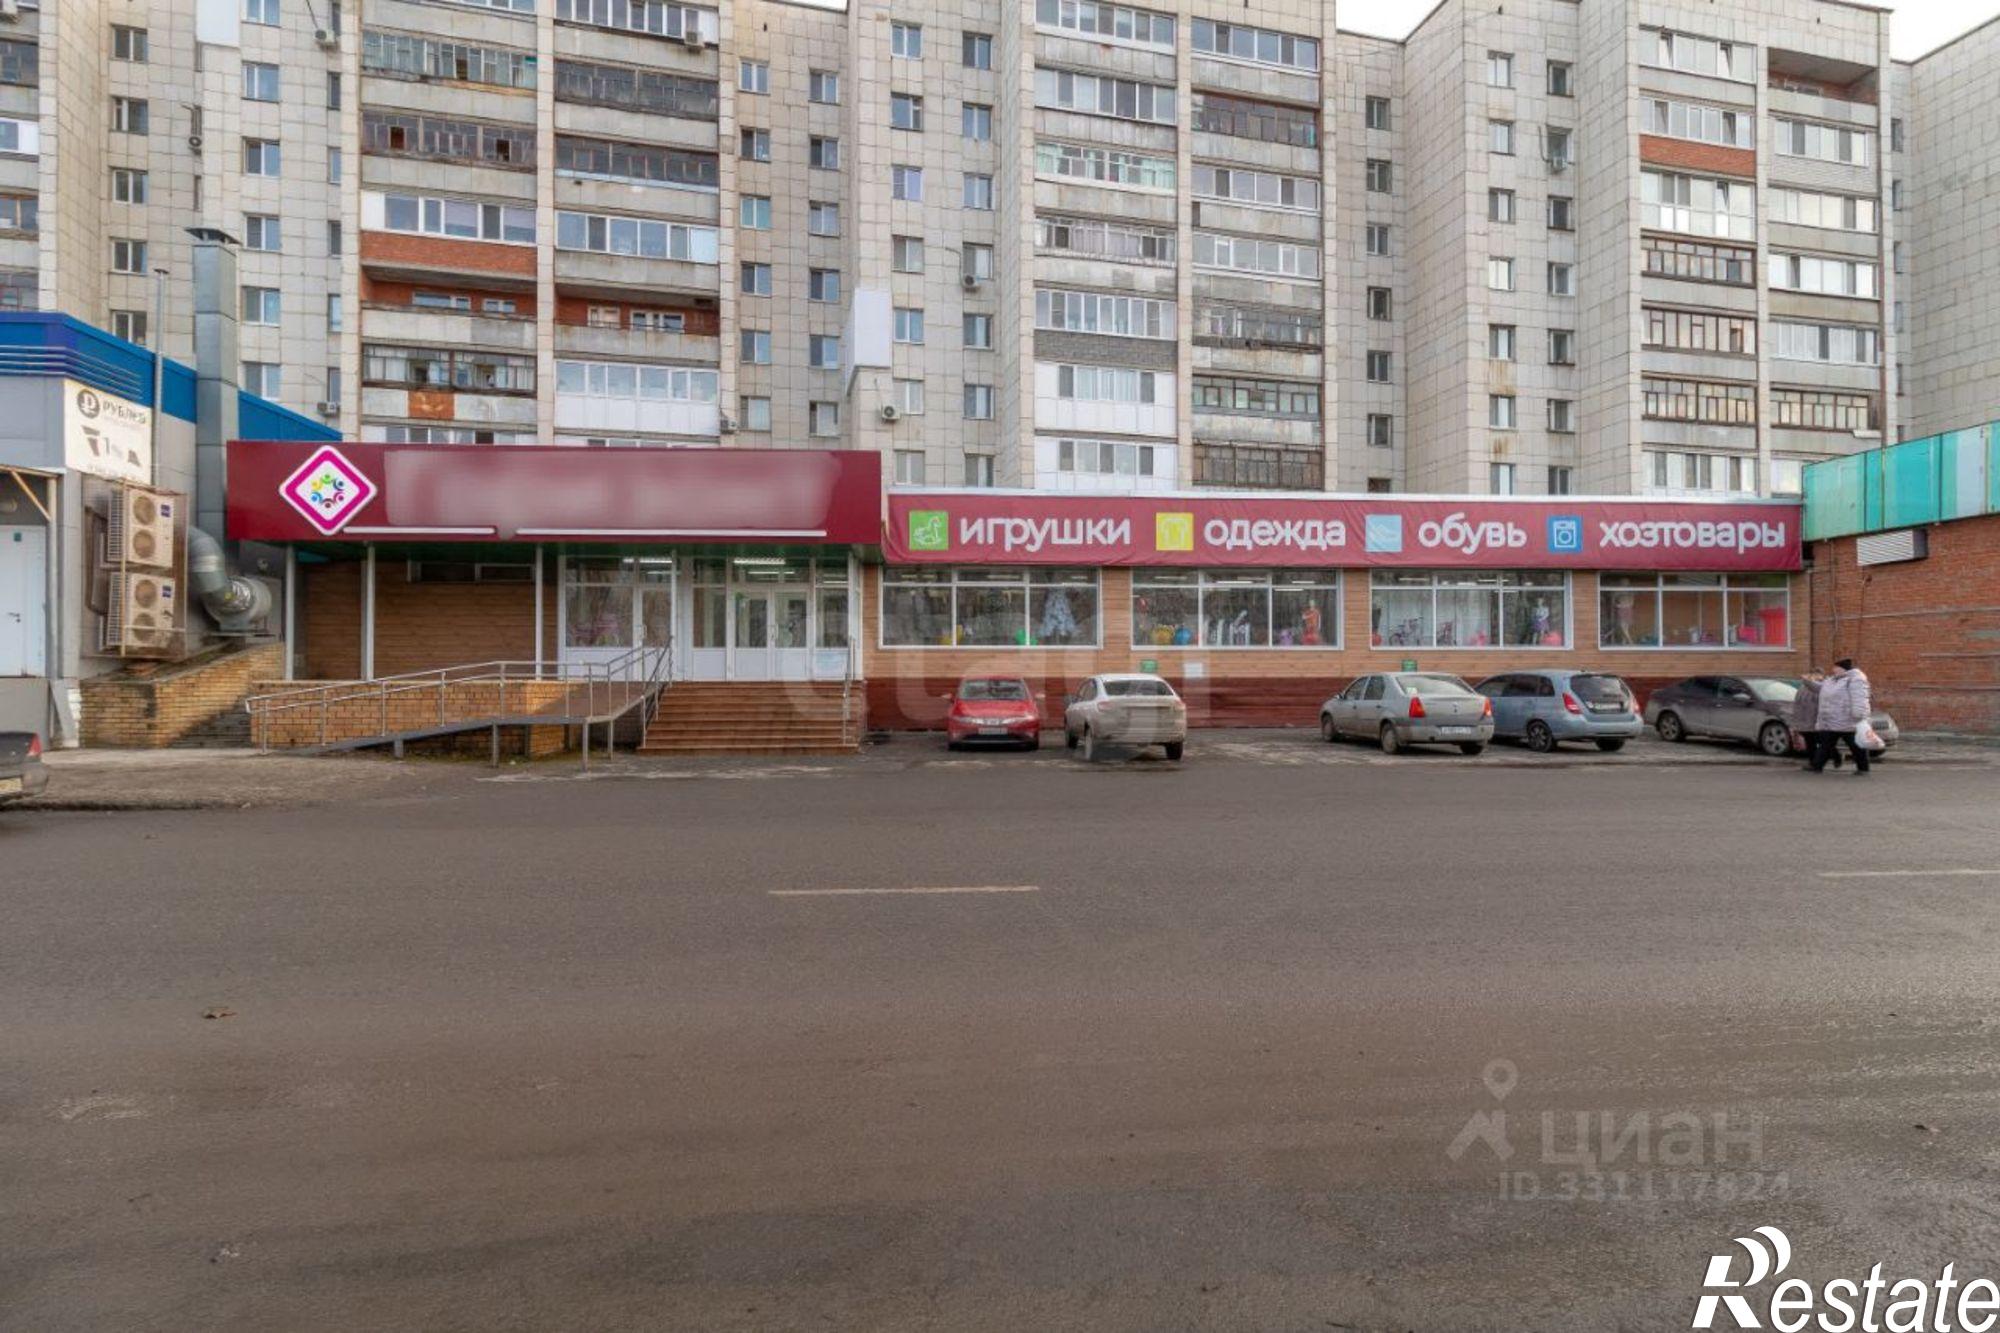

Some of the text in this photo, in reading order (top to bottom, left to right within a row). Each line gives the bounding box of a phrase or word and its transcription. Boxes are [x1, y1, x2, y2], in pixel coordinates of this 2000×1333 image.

[959, 511, 1786, 555] игрушки одежда обувь хозтовары
